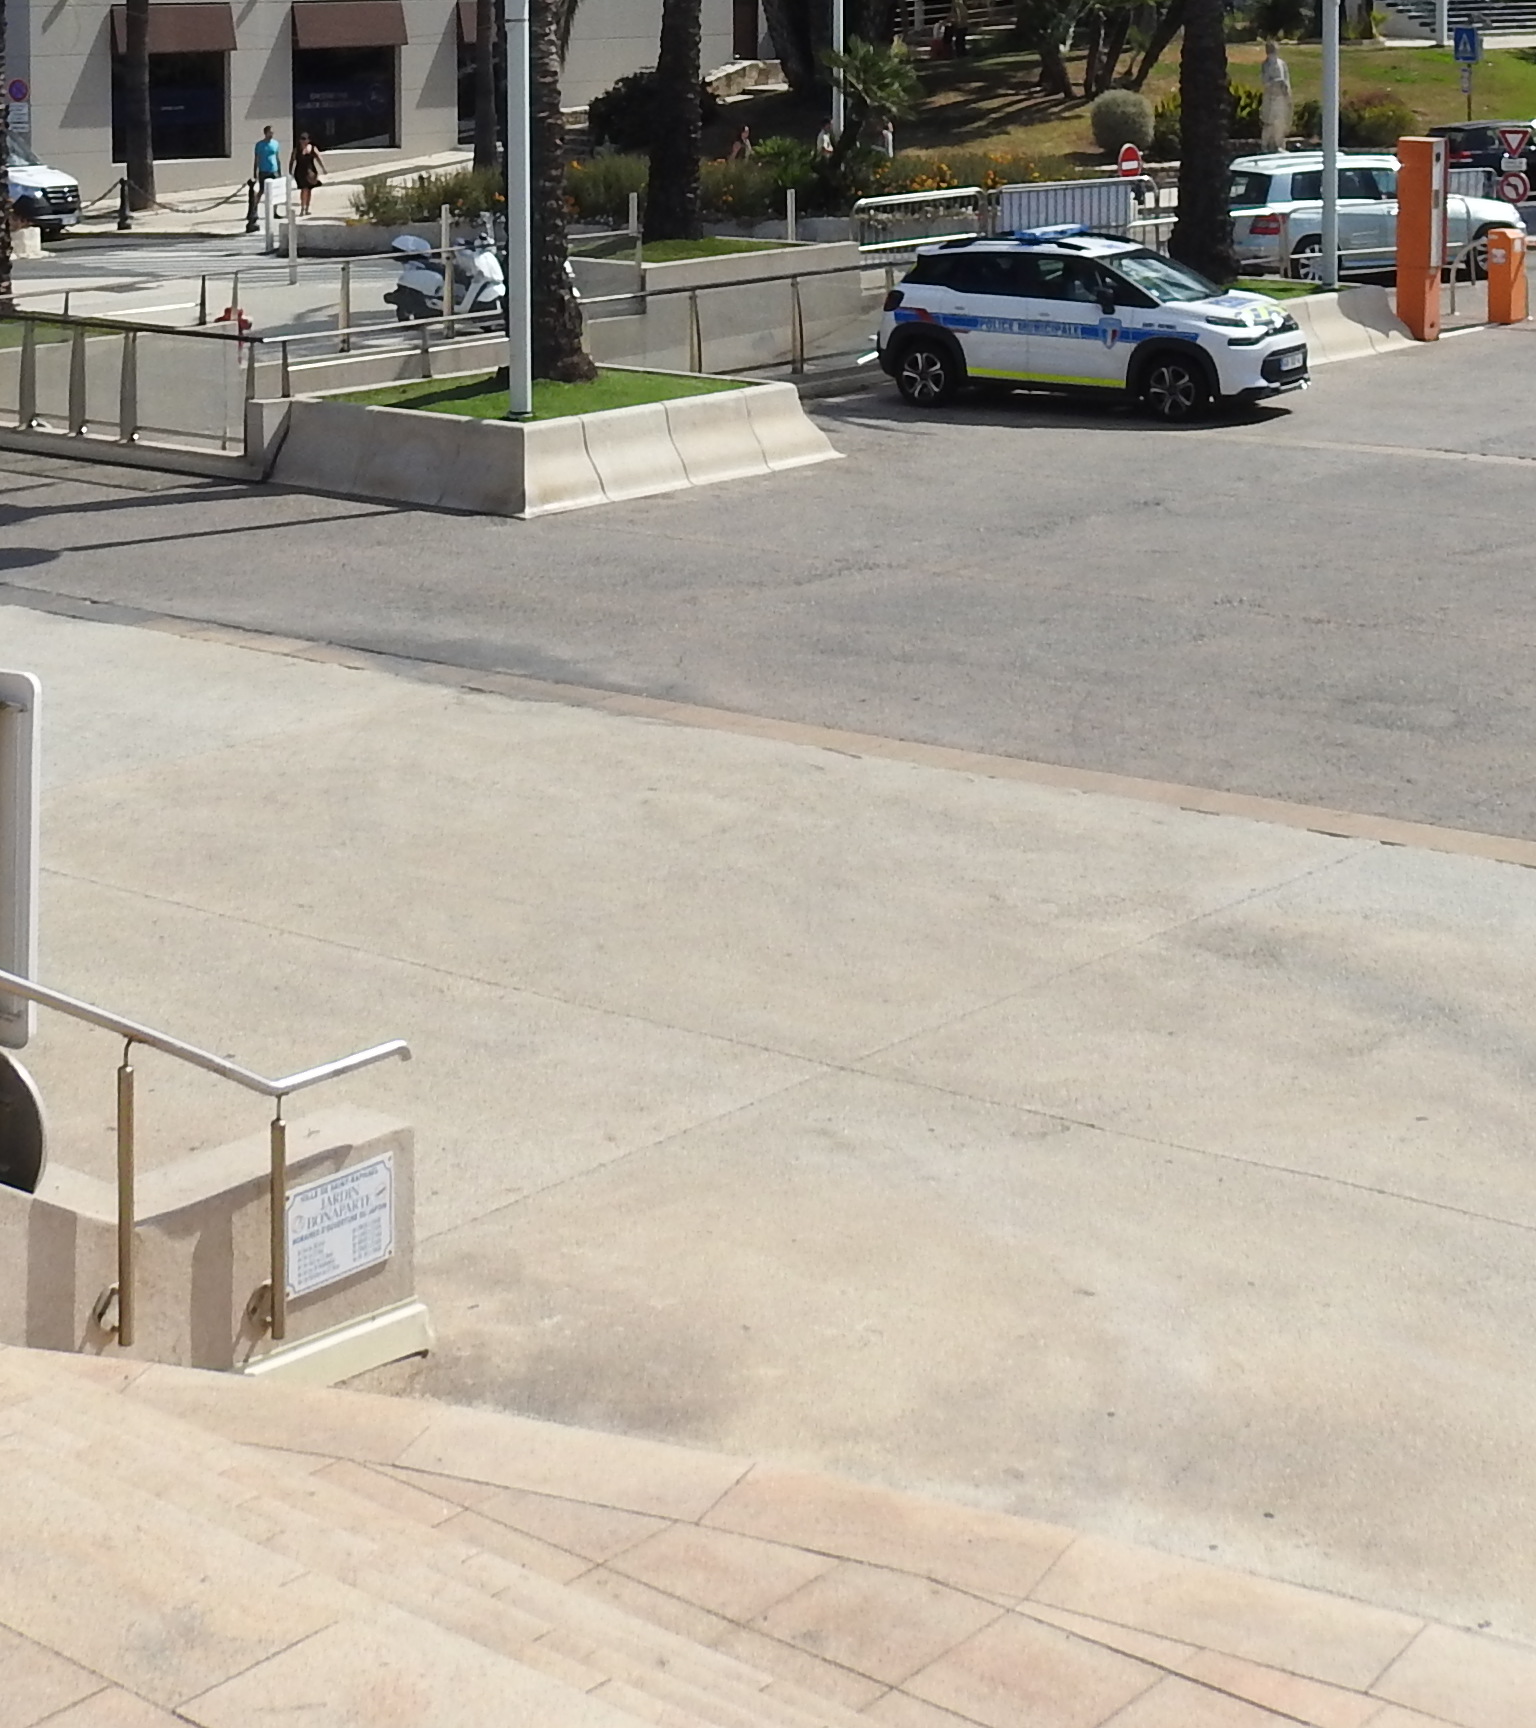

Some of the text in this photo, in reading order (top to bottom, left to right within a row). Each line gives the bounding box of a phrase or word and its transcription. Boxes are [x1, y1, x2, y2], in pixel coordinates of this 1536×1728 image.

[978, 318, 1083, 339] POLICE MUNICIPALE
[306, 1193, 370, 1230] BONAPARTE
[320, 1185, 360, 1212] JARDIN
